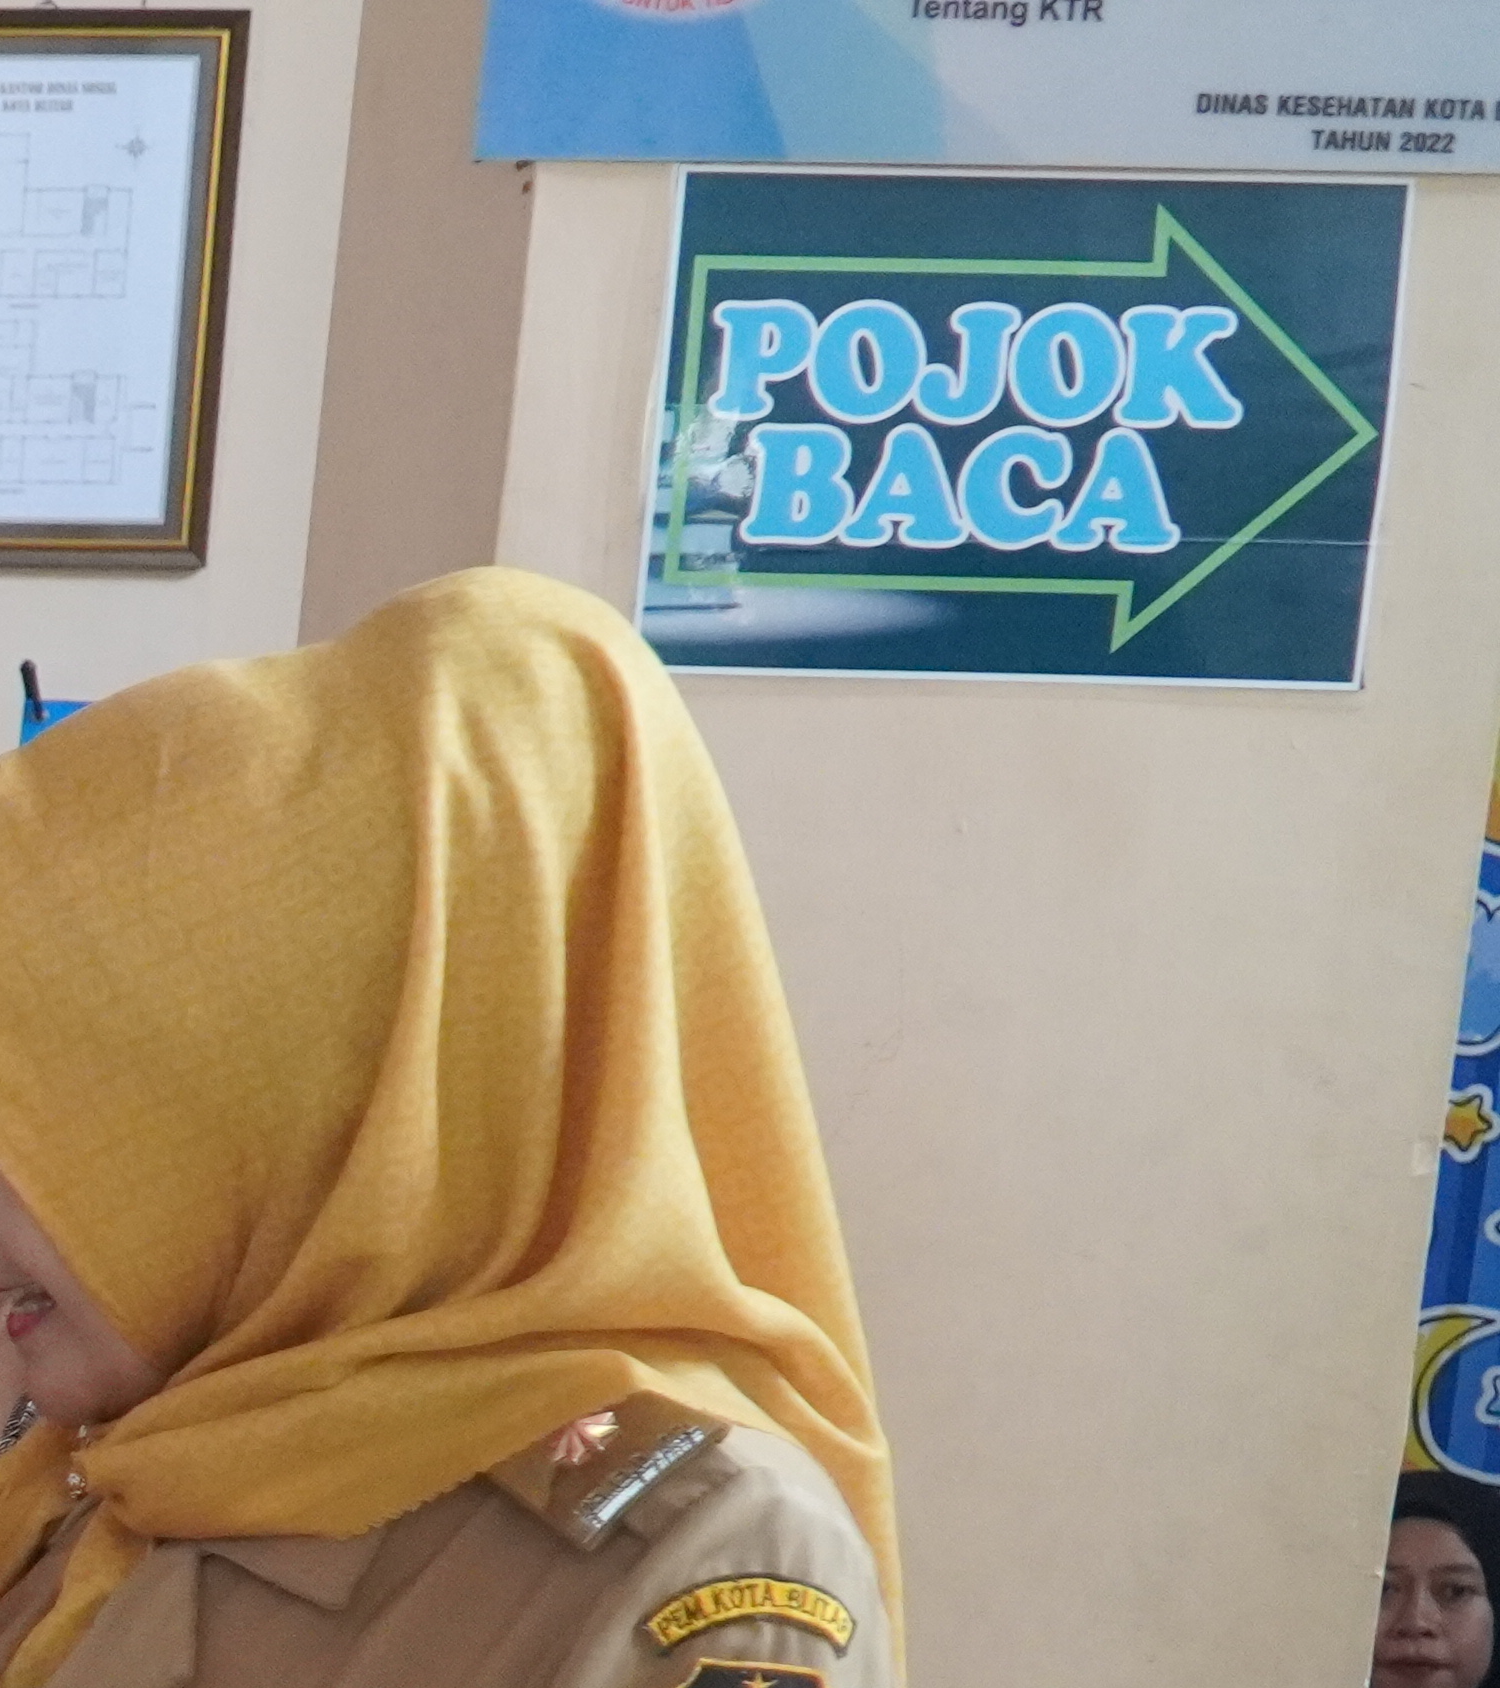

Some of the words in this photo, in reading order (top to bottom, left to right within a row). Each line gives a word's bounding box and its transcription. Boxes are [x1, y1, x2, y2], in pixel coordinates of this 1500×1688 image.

[911, 0, 1028, 27] Tentang
[1196, 93, 1269, 116] DINAS
[1276, 95, 1415, 119] KESEHATAN
[1424, 98, 1486, 121] KOTA
[1311, 129, 1392, 152] TAHUN
[1399, 131, 1456, 153] 2022
[708, 299, 1243, 430] POJOK
[739, 422, 1181, 553] BACA
